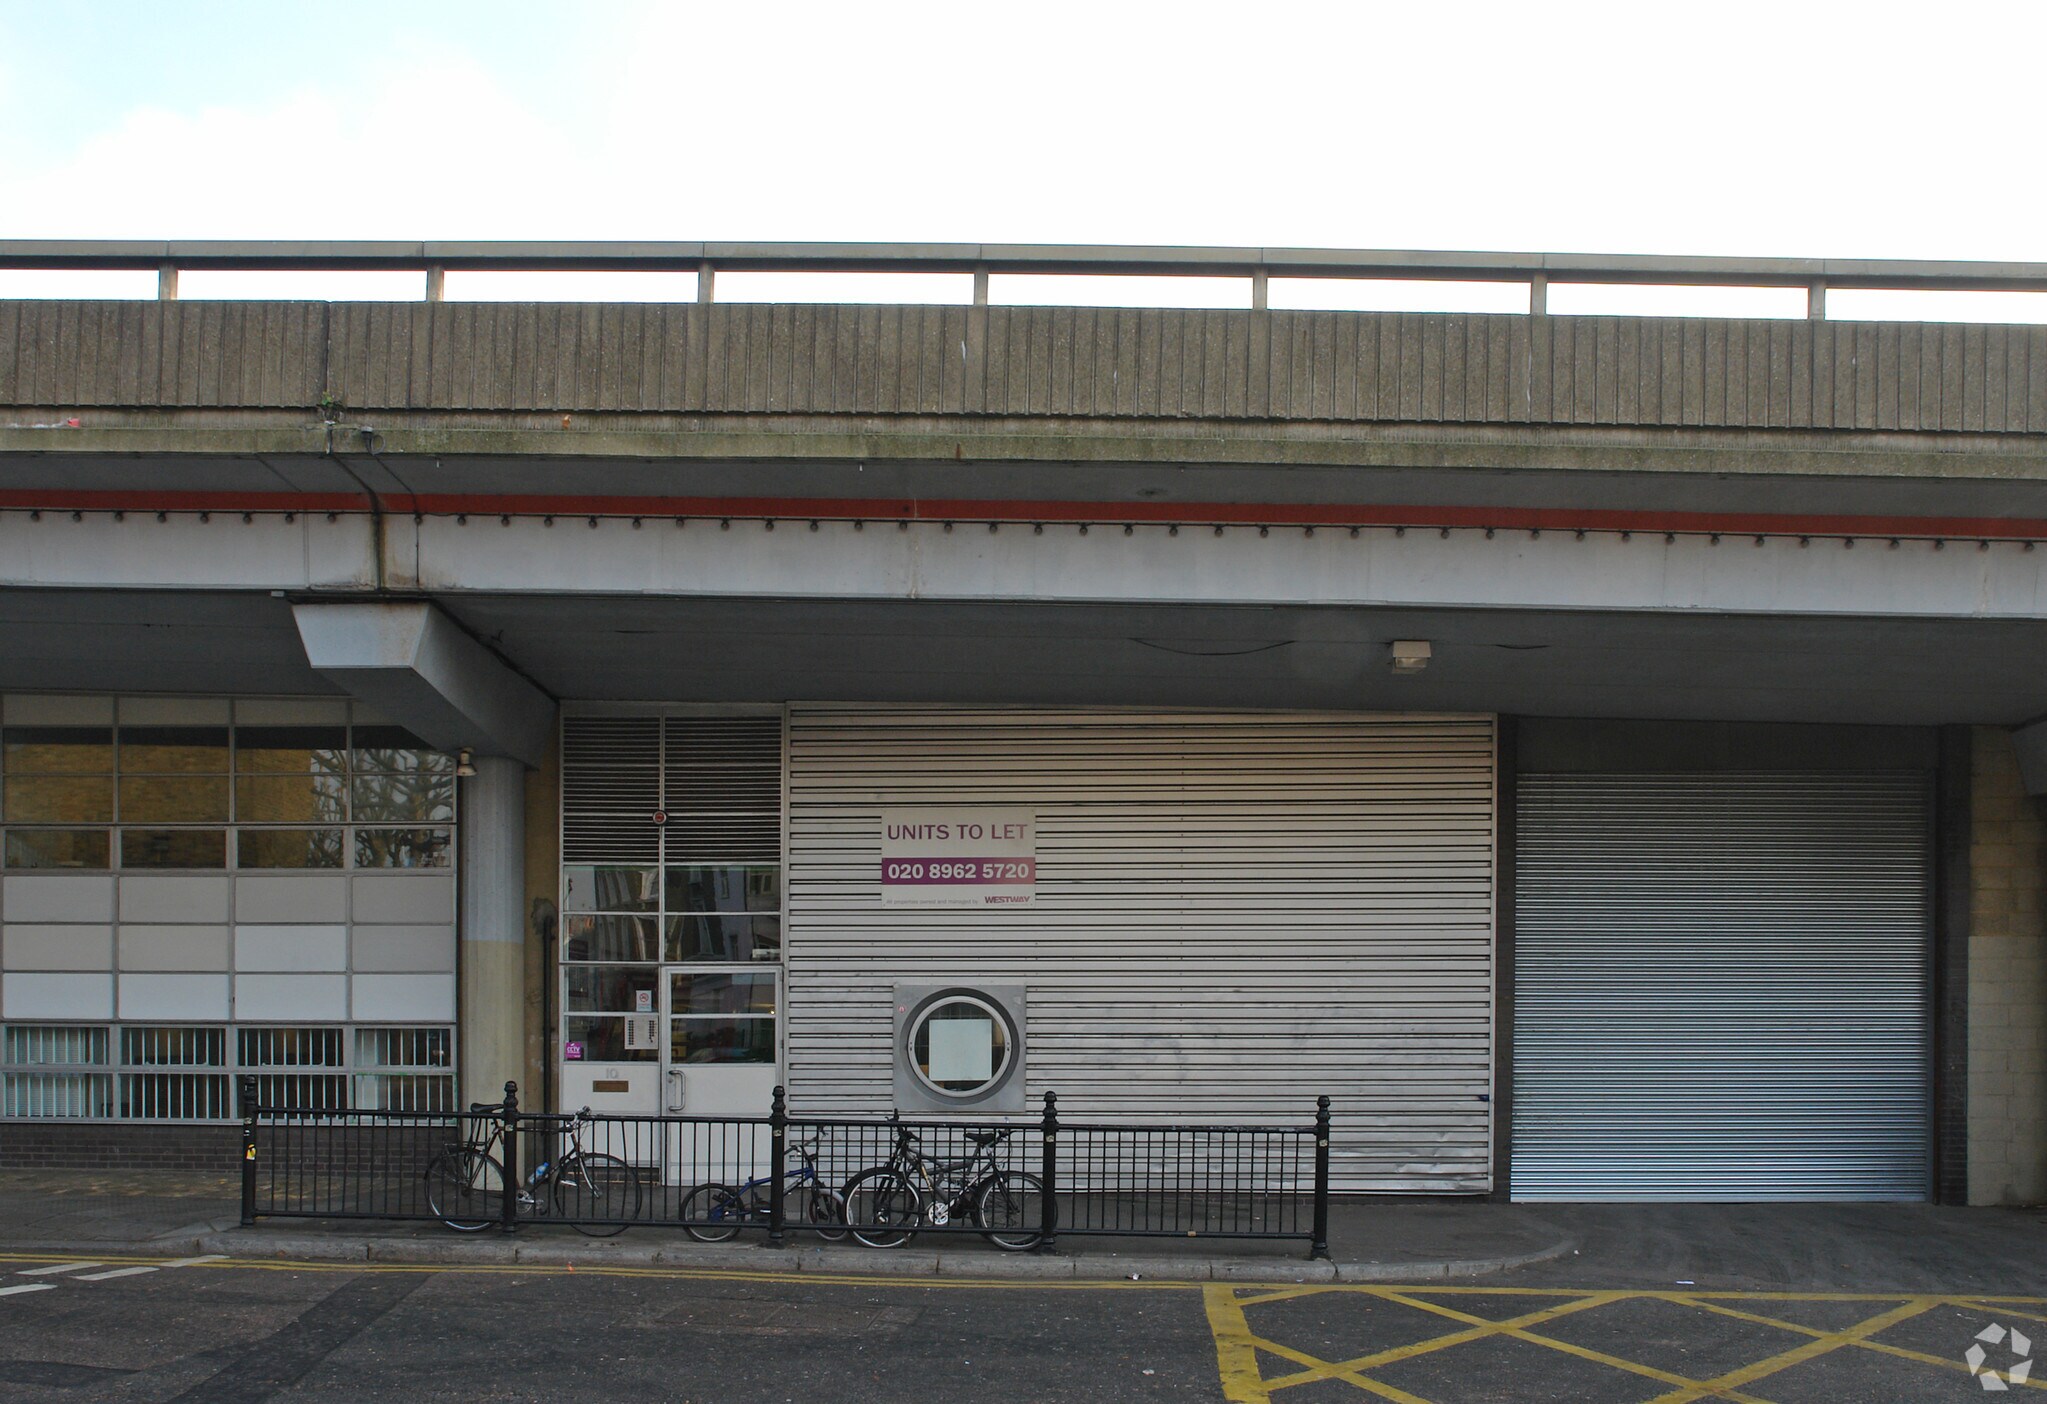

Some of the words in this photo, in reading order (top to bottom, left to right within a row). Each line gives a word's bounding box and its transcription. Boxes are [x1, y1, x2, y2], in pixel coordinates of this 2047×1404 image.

[888, 824, 949, 840] UNITS
[956, 824, 983, 840] TO
[991, 824, 1028, 839] LET
[888, 863, 924, 879] 020
[929, 863, 977, 879] 8962
[982, 863, 1029, 879] 5720
[984, 896, 1030, 904] WESTWAY
